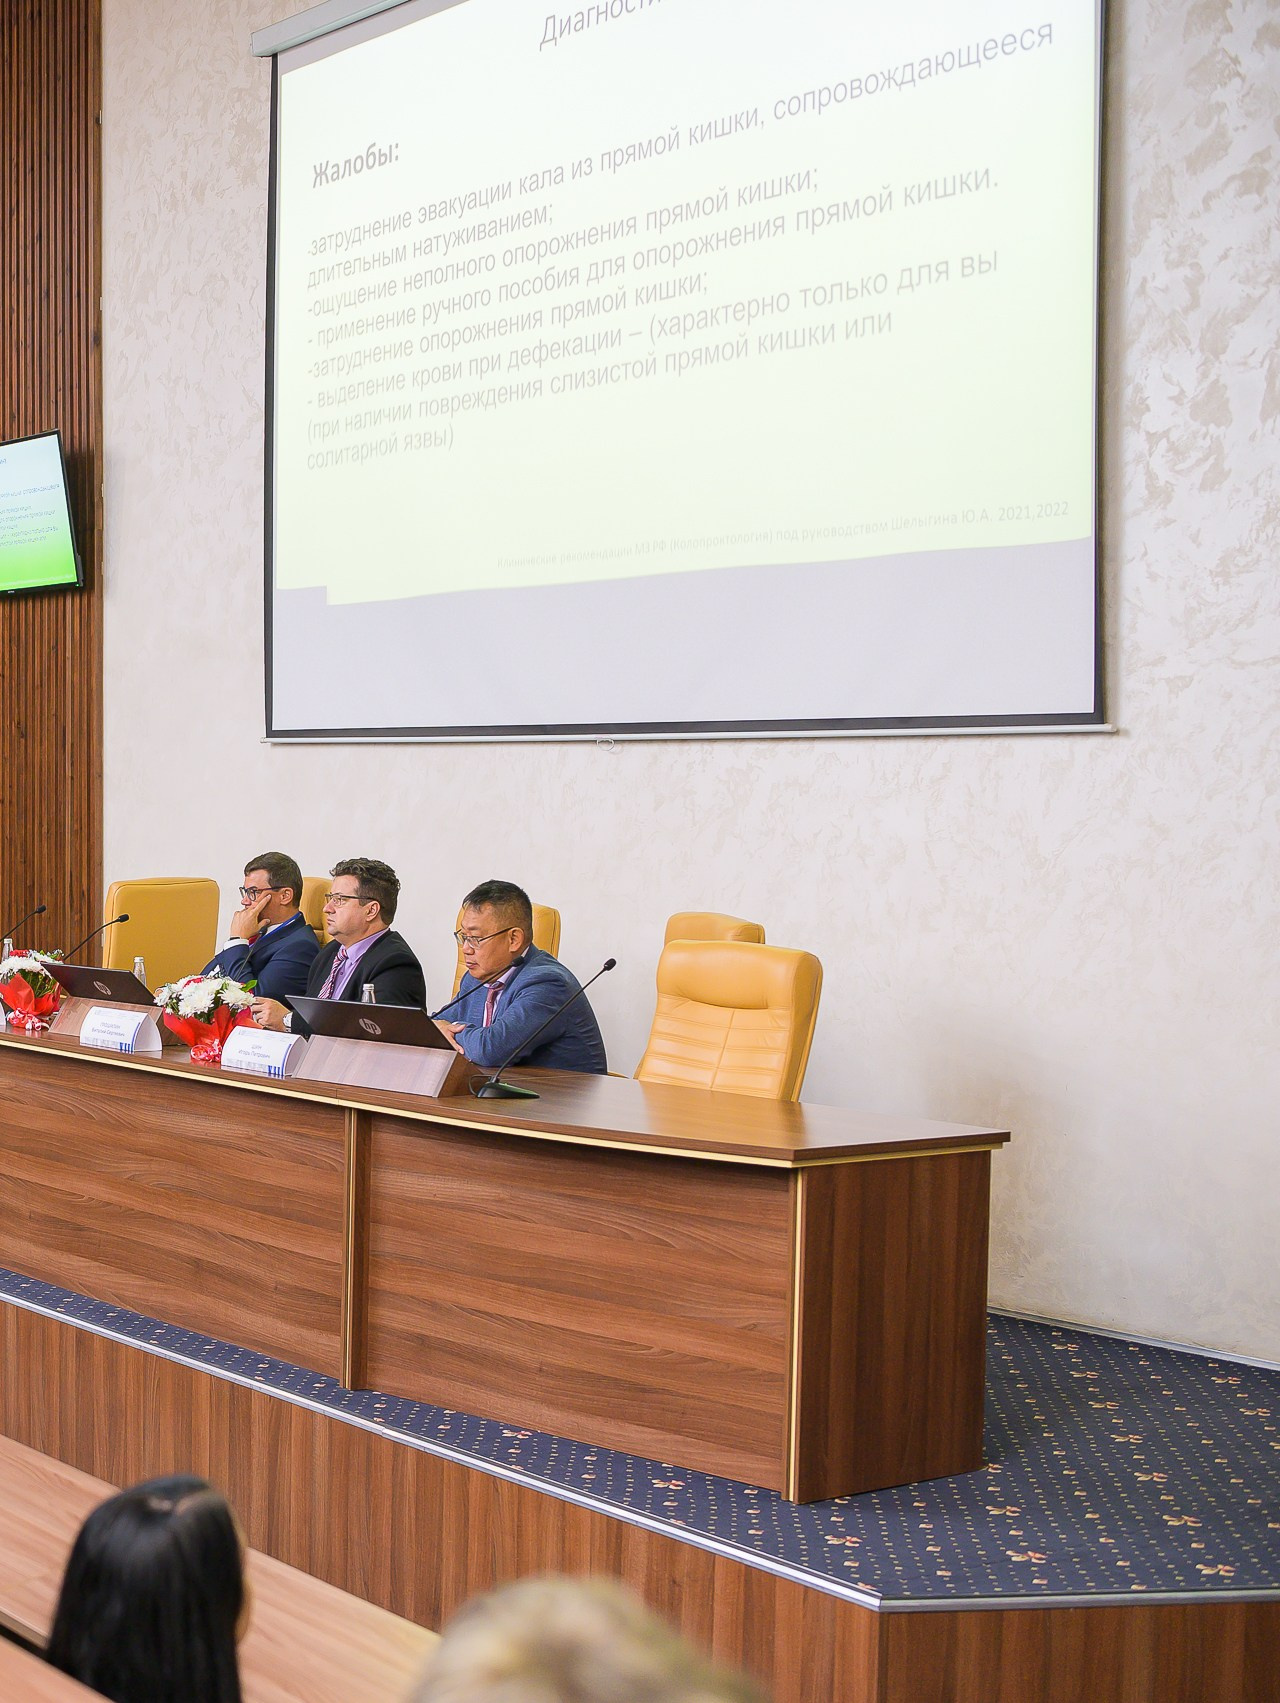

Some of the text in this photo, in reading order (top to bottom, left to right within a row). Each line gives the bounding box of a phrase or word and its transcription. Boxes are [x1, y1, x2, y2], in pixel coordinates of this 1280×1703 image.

[539, 0, 664, 52] Диагнос
[312, 141, 400, 189] Жалобы:
[418, 181, 511, 224] эвакуации
[519, 166, 564, 195] кала
[572, 157, 593, 180] из
[601, 125, 679, 173] прямой
[689, 107, 764, 146] кишки,
[774, 23, 1053, 120] сопровождающееся
[307, 204, 552, 291] длительным натуживанием;
[308, 168, 817, 317] -ощущение неполного опорожнения прямой кишки;
[318, 307, 416, 348] применение
[423, 289, 491, 327] ручного
[499, 265, 579, 303] пособия
[586, 255, 625, 287] для
[633, 215, 785, 270] опорожнения
[796, 184, 892, 235] прямой
[904, 168, 998, 207] кишки.
[308, 272, 707, 378] -затруднение опорожнения прямой кишки;
[318, 373, 405, 408] выделение
[412, 361, 462, 391] крови
[469, 353, 501, 380] при
[507, 328, 621, 373] дефекации
[650, 292, 790, 345] (характерно
[799, 273, 888, 308] только
[897, 260, 949, 295] для
[961, 250, 997, 278] вы
[308, 312, 891, 444] (при наличии повреждения слизистой прямой кишки или
[308, 424, 453, 470] солитарной язвы)
[776, 529, 799, 543] под
[998, 501, 1068, 521] 2021,2022
[360, 1018, 380, 1034] hp
